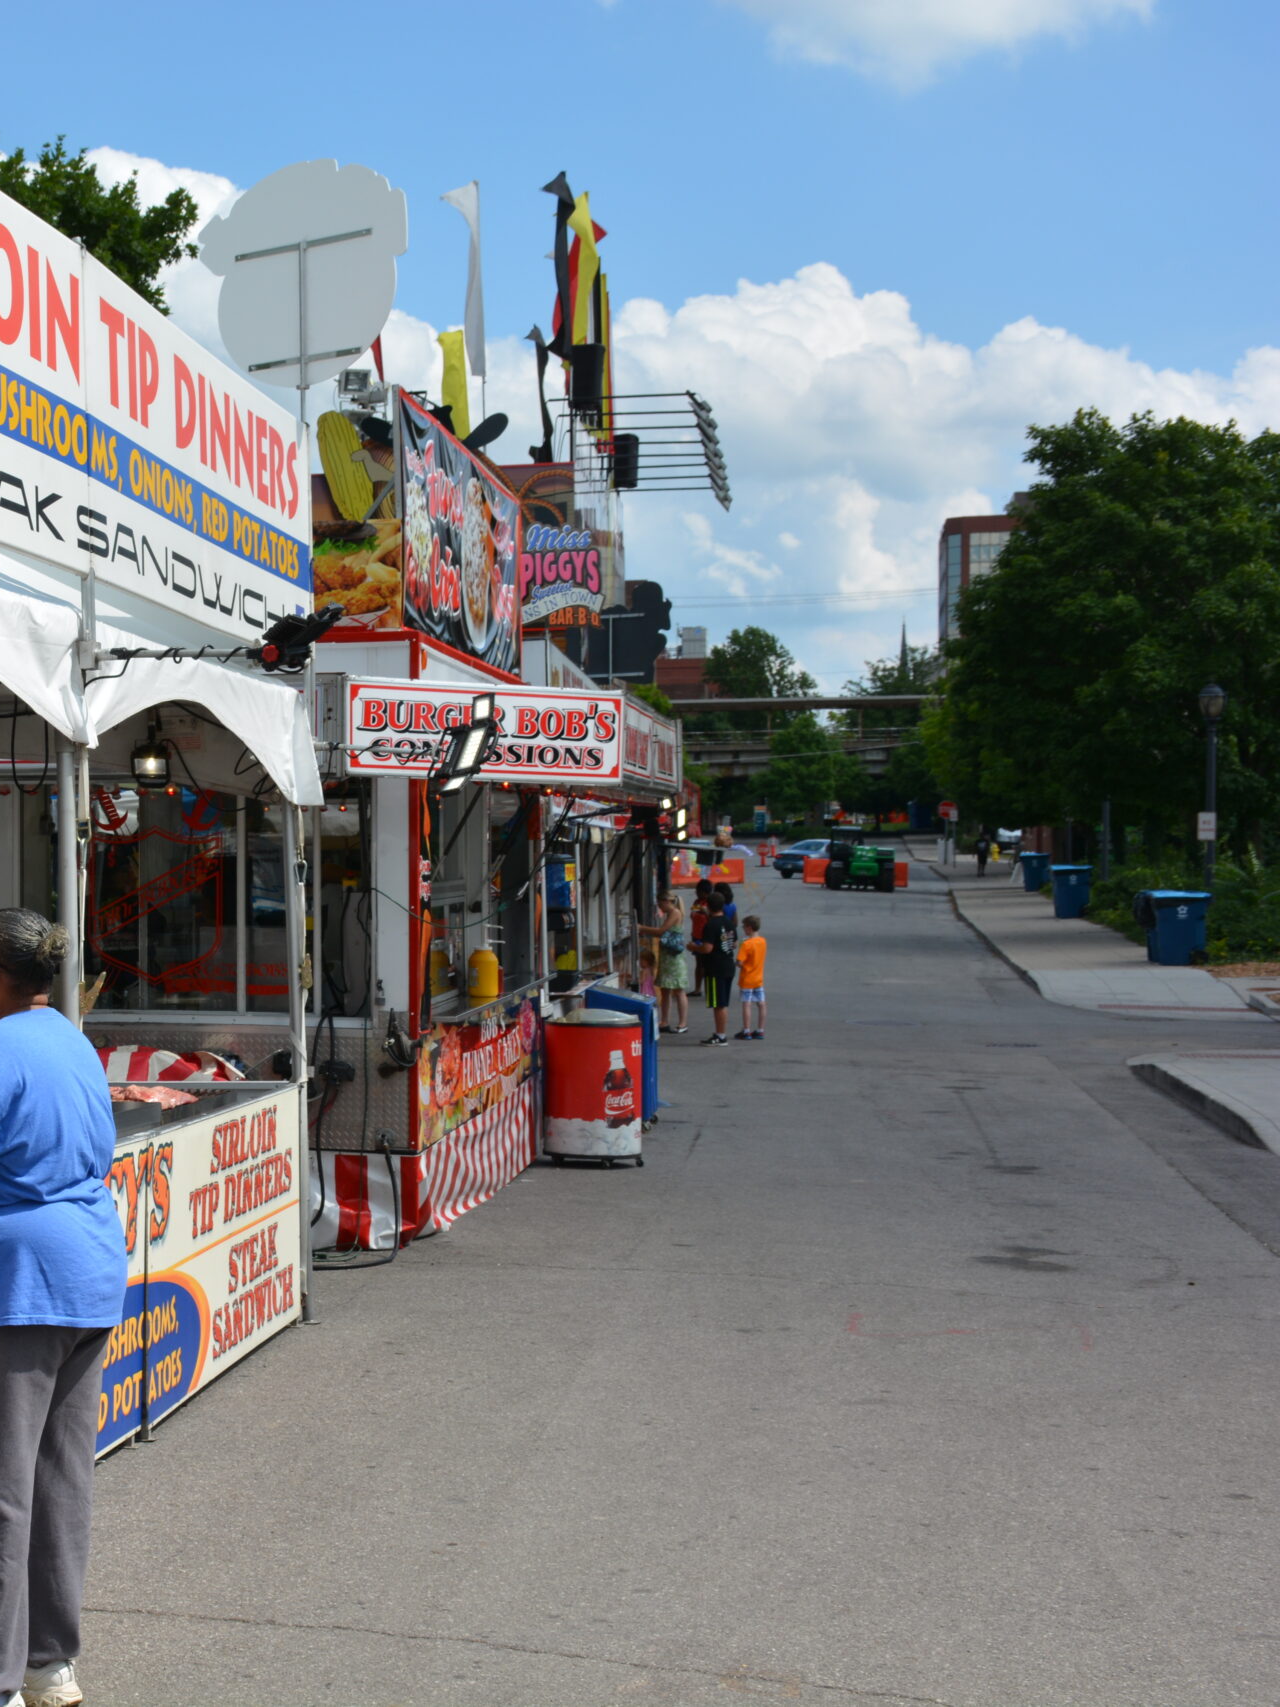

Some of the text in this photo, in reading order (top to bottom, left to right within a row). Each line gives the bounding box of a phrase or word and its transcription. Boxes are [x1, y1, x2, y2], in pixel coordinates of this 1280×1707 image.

[99, 296, 159, 428] TIP
[174, 353, 298, 520] DINNERS
[129, 449, 197, 535] ONIONS,
[202, 493, 228, 542] RED
[233, 510, 299, 580] POTATOES
[526, 524, 591, 551] Miss
[76, 505, 284, 629] SANDWICH
[520, 550, 600, 600] PIGGYS
[544, 598, 558, 612] IN
[562, 590, 598, 606] TOWN
[370, 736, 604, 770] CONSSIONS
[514, 702, 616, 742] BOB'S
[462, 1045, 496, 1094] FUNNEL
[211, 1104, 277, 1175] SIRLOIN
[189, 1148, 292, 1240] TIP DINNERS
[228, 1222, 279, 1294] STEAK
[212, 1264, 294, 1361] SANDWICH
[113, 1347, 182, 1422] POTATOES
